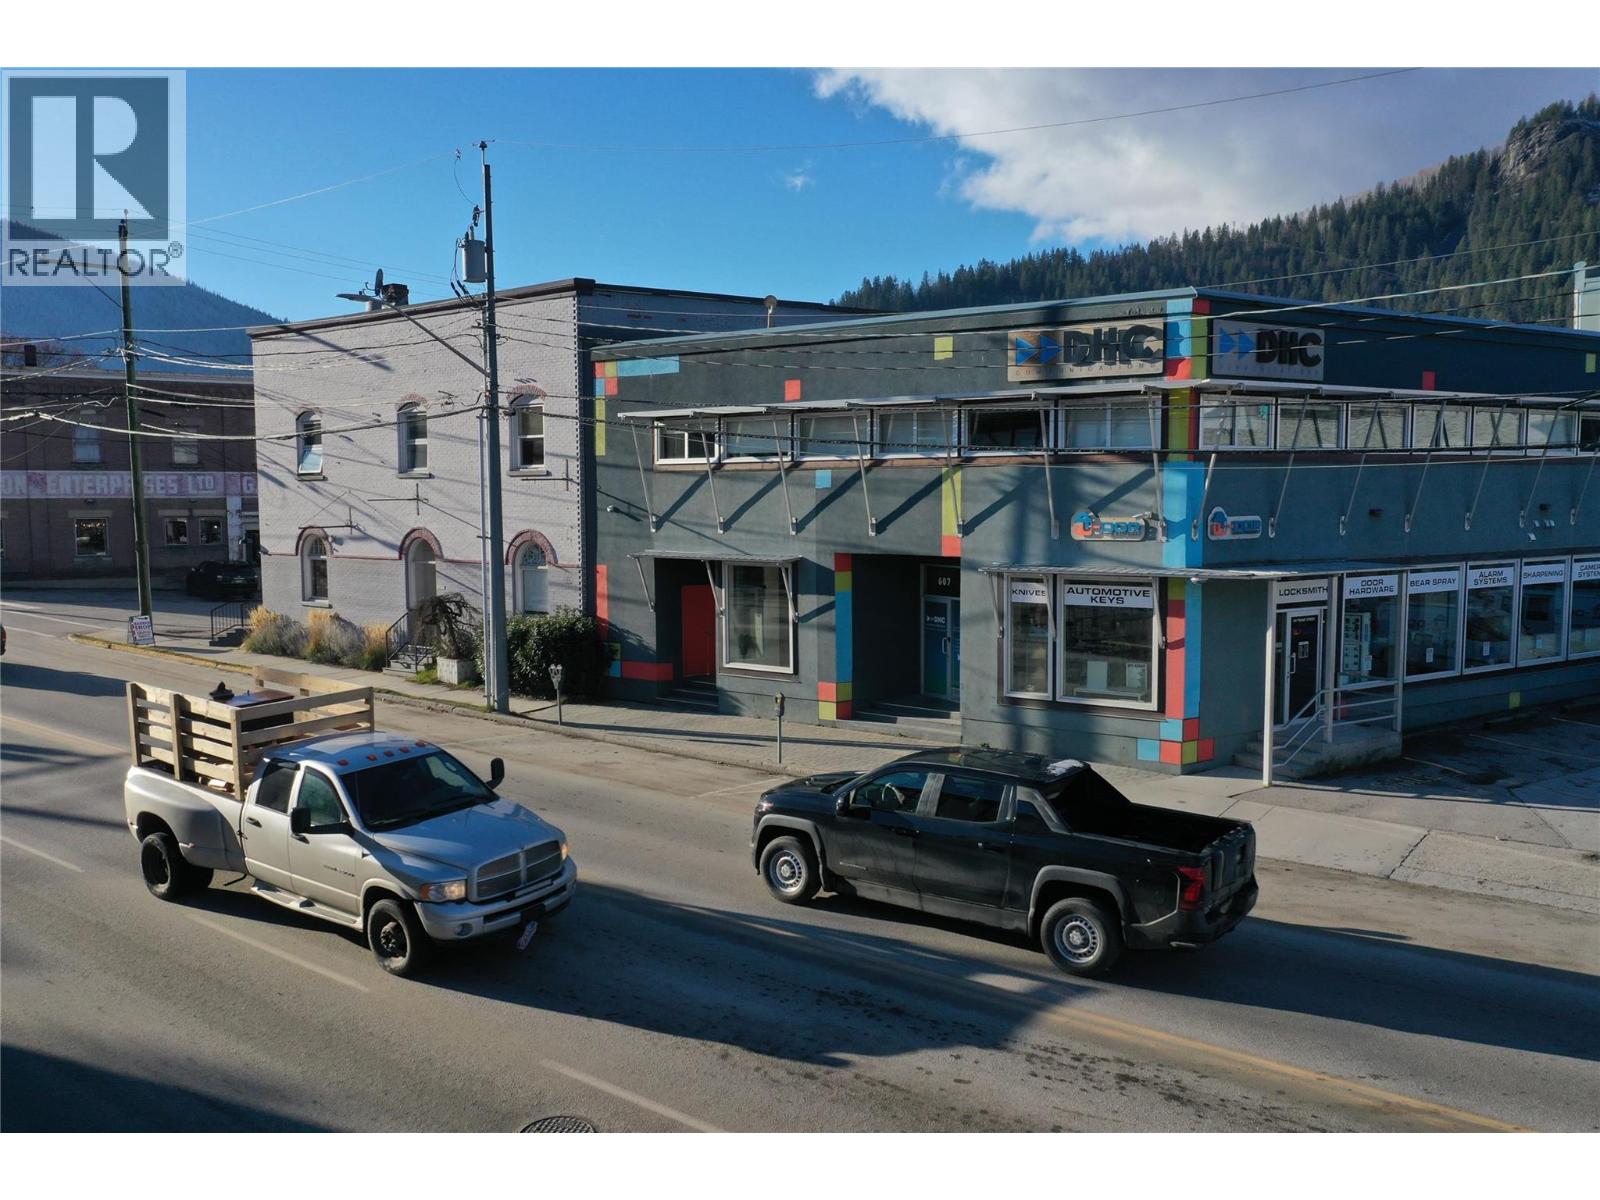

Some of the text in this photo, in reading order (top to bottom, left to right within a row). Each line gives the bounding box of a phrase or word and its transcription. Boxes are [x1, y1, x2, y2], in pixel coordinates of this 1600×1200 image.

[1064, 325, 1163, 365] DHC
[1256, 328, 1322, 367] DHC
[46, 475, 178, 494] ENTERPRSES
[187, 475, 216, 494] LTD
[1478, 570, 1504, 578] ALARM
[1523, 570, 1563, 578] SHARPENING
[1361, 579, 1384, 587] DOOR
[1410, 578, 1457, 587] BEAR SPRAY
[1473, 576, 1508, 586] SYSTEMS
[1066, 587, 1151, 598] AUTOMOTIVE
[1279, 587, 1328, 596] LOCKSMITH
[1349, 586, 1395, 595] HARDWARE
[1090, 595, 1125, 605] KEYS
